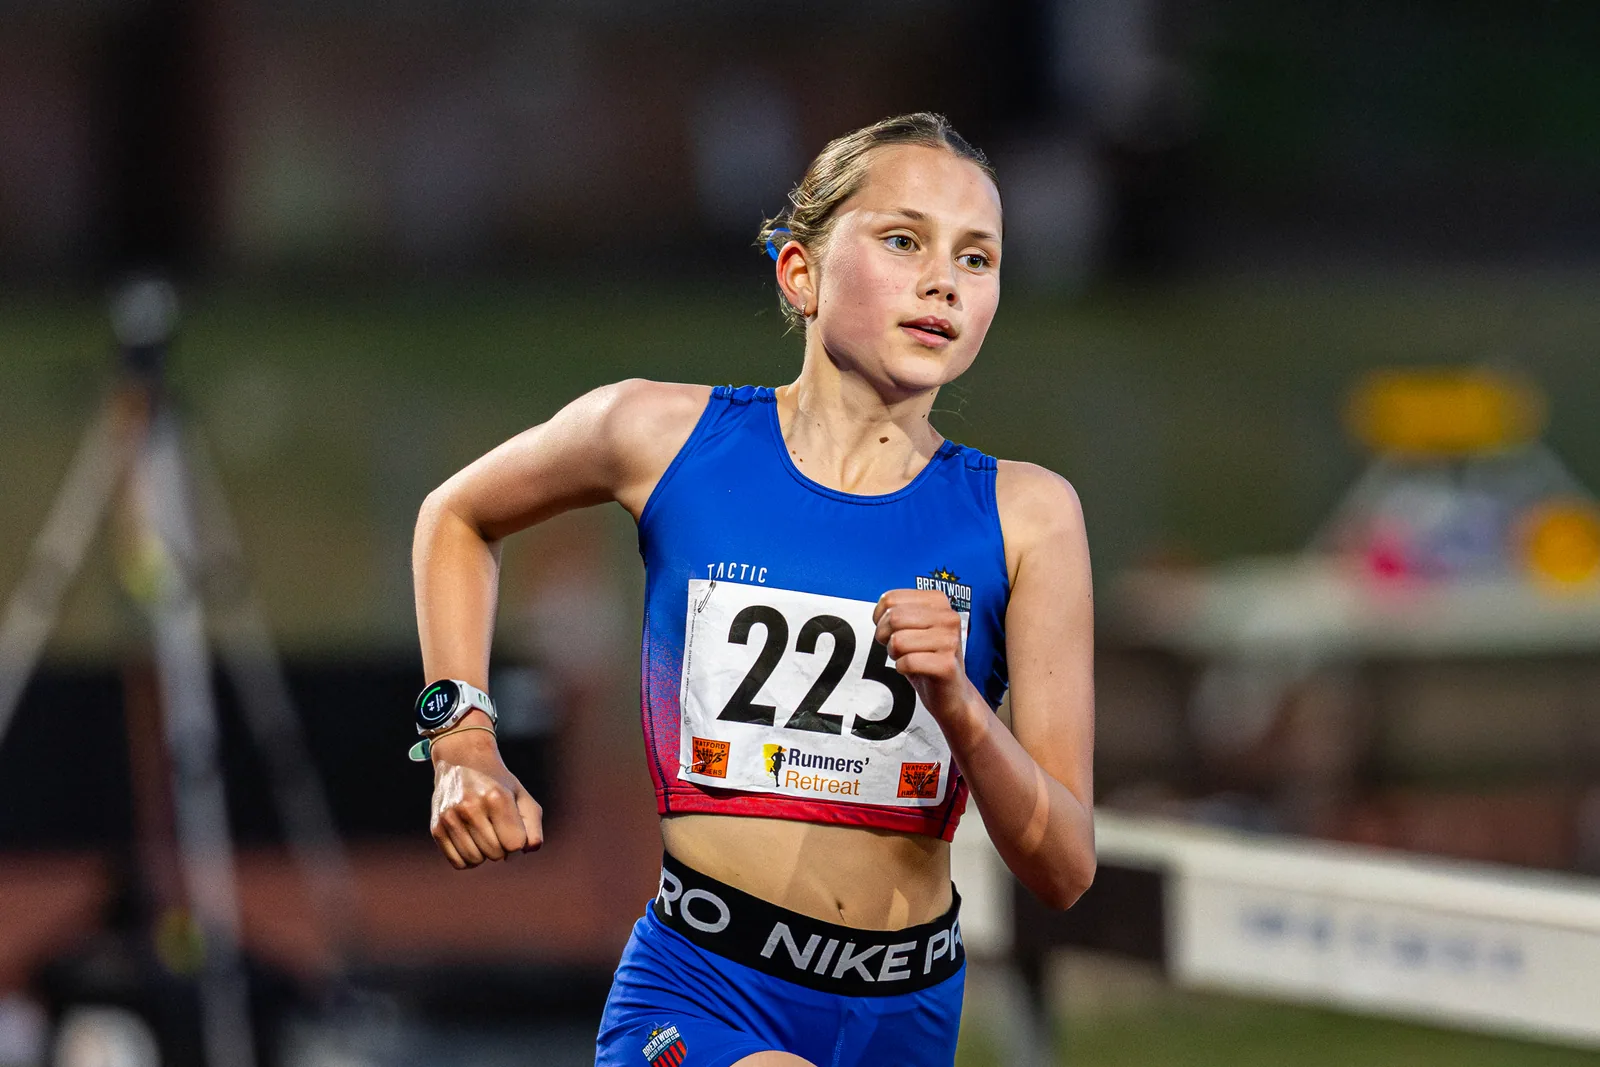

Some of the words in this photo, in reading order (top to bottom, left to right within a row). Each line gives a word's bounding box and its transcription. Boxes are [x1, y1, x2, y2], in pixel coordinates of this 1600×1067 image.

[707, 562, 768, 583] TACTIC
[916, 576, 971, 601] BRENTWOOD
[716, 605, 917, 741] 225
[788, 748, 870, 774] Runners'
[785, 770, 861, 796] Retreat
[760, 921, 917, 982] NIKE
[642, 1026, 677, 1057] BRENTWOOD
